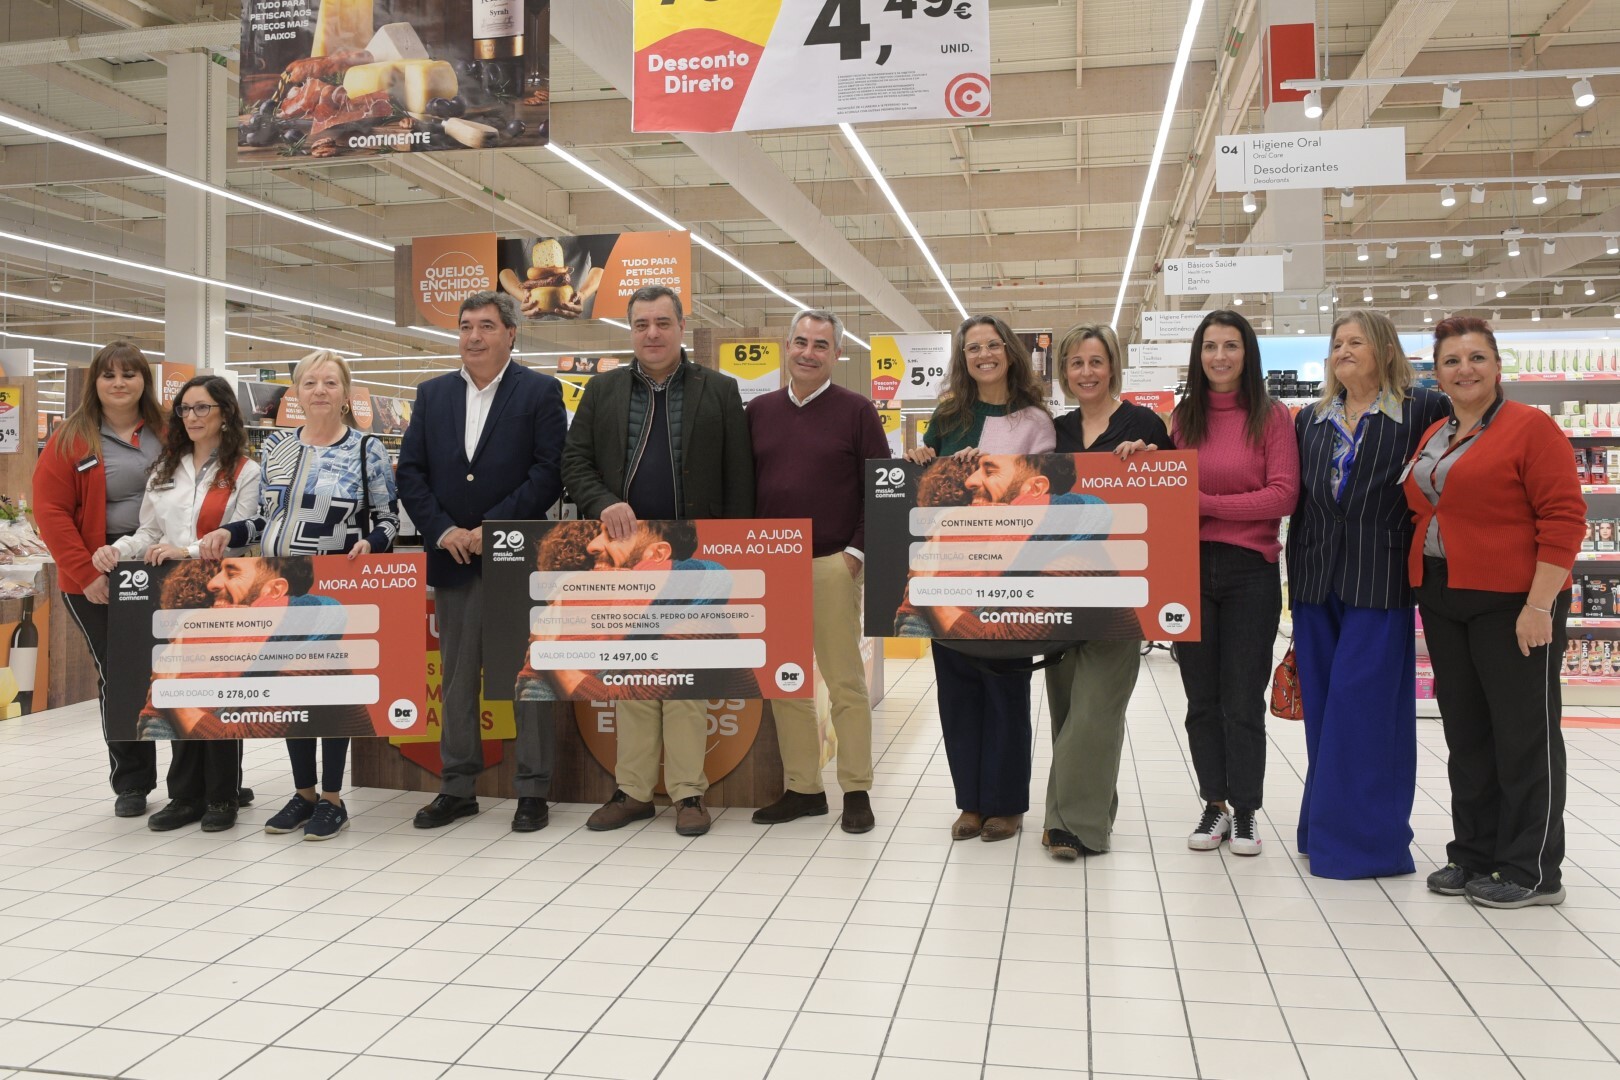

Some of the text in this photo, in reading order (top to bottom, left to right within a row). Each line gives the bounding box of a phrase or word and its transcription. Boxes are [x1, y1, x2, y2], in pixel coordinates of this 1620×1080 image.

[257, 1, 281, 10] TUDO
[250, 9, 312, 21] PETISCAR AOS
[490, 8, 509, 17] Syrah
[252, 20, 309, 31] PREÇOS MAIS
[265, 32, 296, 41] BAIXOS
[941, 44, 973, 54] UNID.
[648, 51, 749, 72] Desconto
[665, 74, 734, 94] Direto
[349, 132, 430, 148] CONTINENTE
[1221, 137, 1322, 154] 04 Higiene Oral
[1254, 163, 1338, 174] Desodorizantes
[622, 258, 648, 267] TUDO
[425, 265, 485, 280] QUEIJOS
[626, 268, 673, 276] PETISCAR
[420, 277, 490, 291] ENCHIDOS
[642, 277, 680, 286] PREÇOS
[423, 292, 431, 303] E
[735, 345, 769, 362] 65%
[876, 358, 897, 370] 15%
[1127, 461, 1187, 472] A AJUDA
[1082, 476, 1187, 488] MORA AO LADO
[941, 519, 994, 527] CONTINENTE
[995, 518, 1034, 528] MONTIJO
[747, 529, 802, 540] A AJUDA
[703, 543, 802, 554] MORA AO LADO
[916, 551, 964, 561] INSTITUIÇÃO
[362, 563, 417, 575] A AJUDA
[319, 577, 417, 590] MORA AO LADO
[617, 584, 656, 593] MONTIJO
[943, 587, 972, 595] DOADO
[976, 590, 985, 598] 11
[987, 590, 1023, 599] 497,00
[1026, 590, 1034, 598] €
[538, 616, 586, 625] INSTITUIÇÃO
[660, 612, 686, 620] PEDRO
[980, 612, 1072, 624] CONTINENTE
[184, 621, 234, 630] CONTINENTE
[236, 620, 273, 629] MONTIJO
[160, 654, 206, 663] INSTITUIÇÃO
[210, 653, 257, 662] ASSOCIAÇÃO
[600, 653, 609, 661] 12
[612, 653, 648, 662] 497,00
[651, 653, 658, 661] €
[602, 673, 694, 686] CONTINENTE
[218, 690, 223, 698] 8
[227, 690, 259, 699] 278,00
[263, 690, 270, 698] €
[220, 710, 309, 723] CONTINENTE
[598, 712, 614, 732] E
